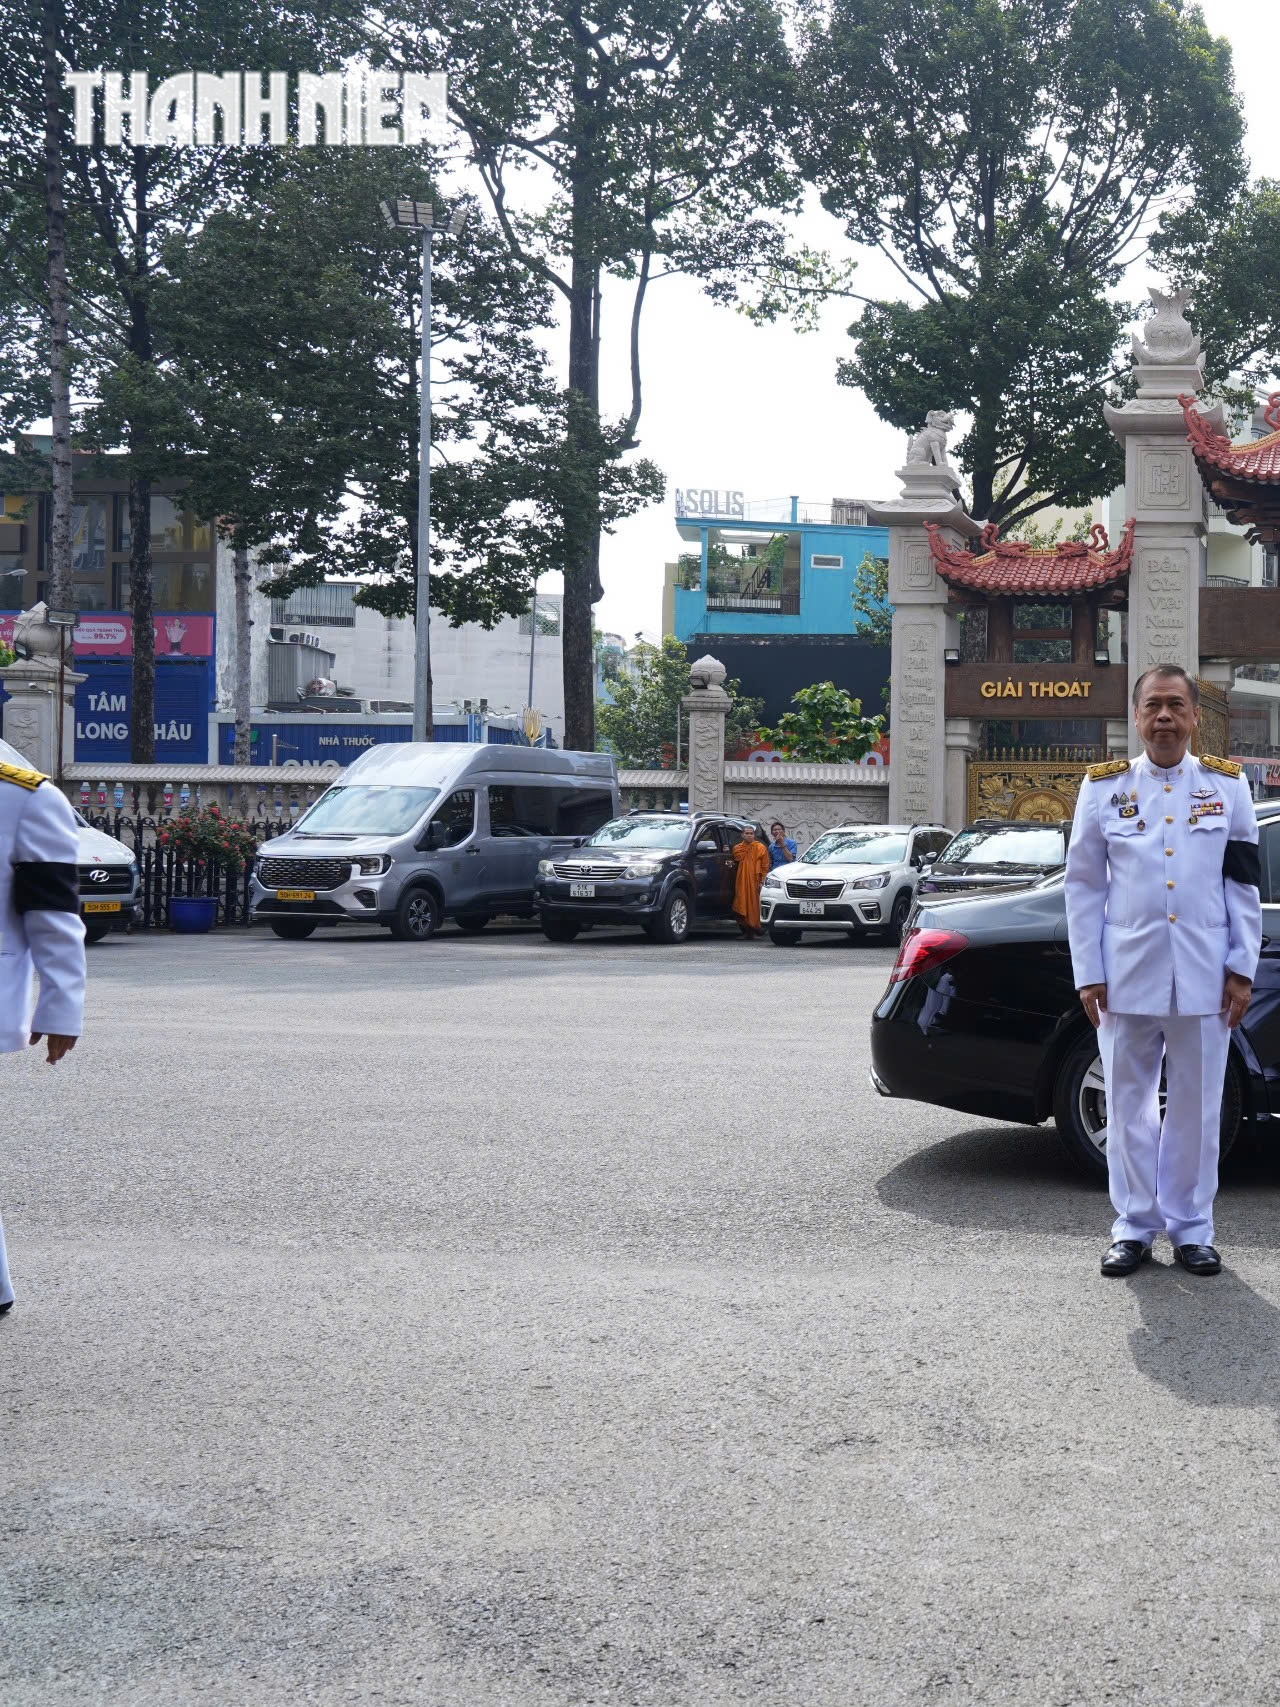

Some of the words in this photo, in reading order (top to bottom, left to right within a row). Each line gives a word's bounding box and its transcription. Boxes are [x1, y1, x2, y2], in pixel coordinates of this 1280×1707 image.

[685, 488, 744, 515] SOLIS
[1145, 615, 1185, 629] Nam
[981, 676, 1023, 698] GIẢI
[1029, 676, 1092, 698] THOÁT
[88, 691, 126, 712] TÂM
[76, 723, 129, 740] LONG
[154, 720, 192, 740] HÂU
[318, 734, 340, 746] NHÀ
[343, 734, 376, 747] THUỐC
